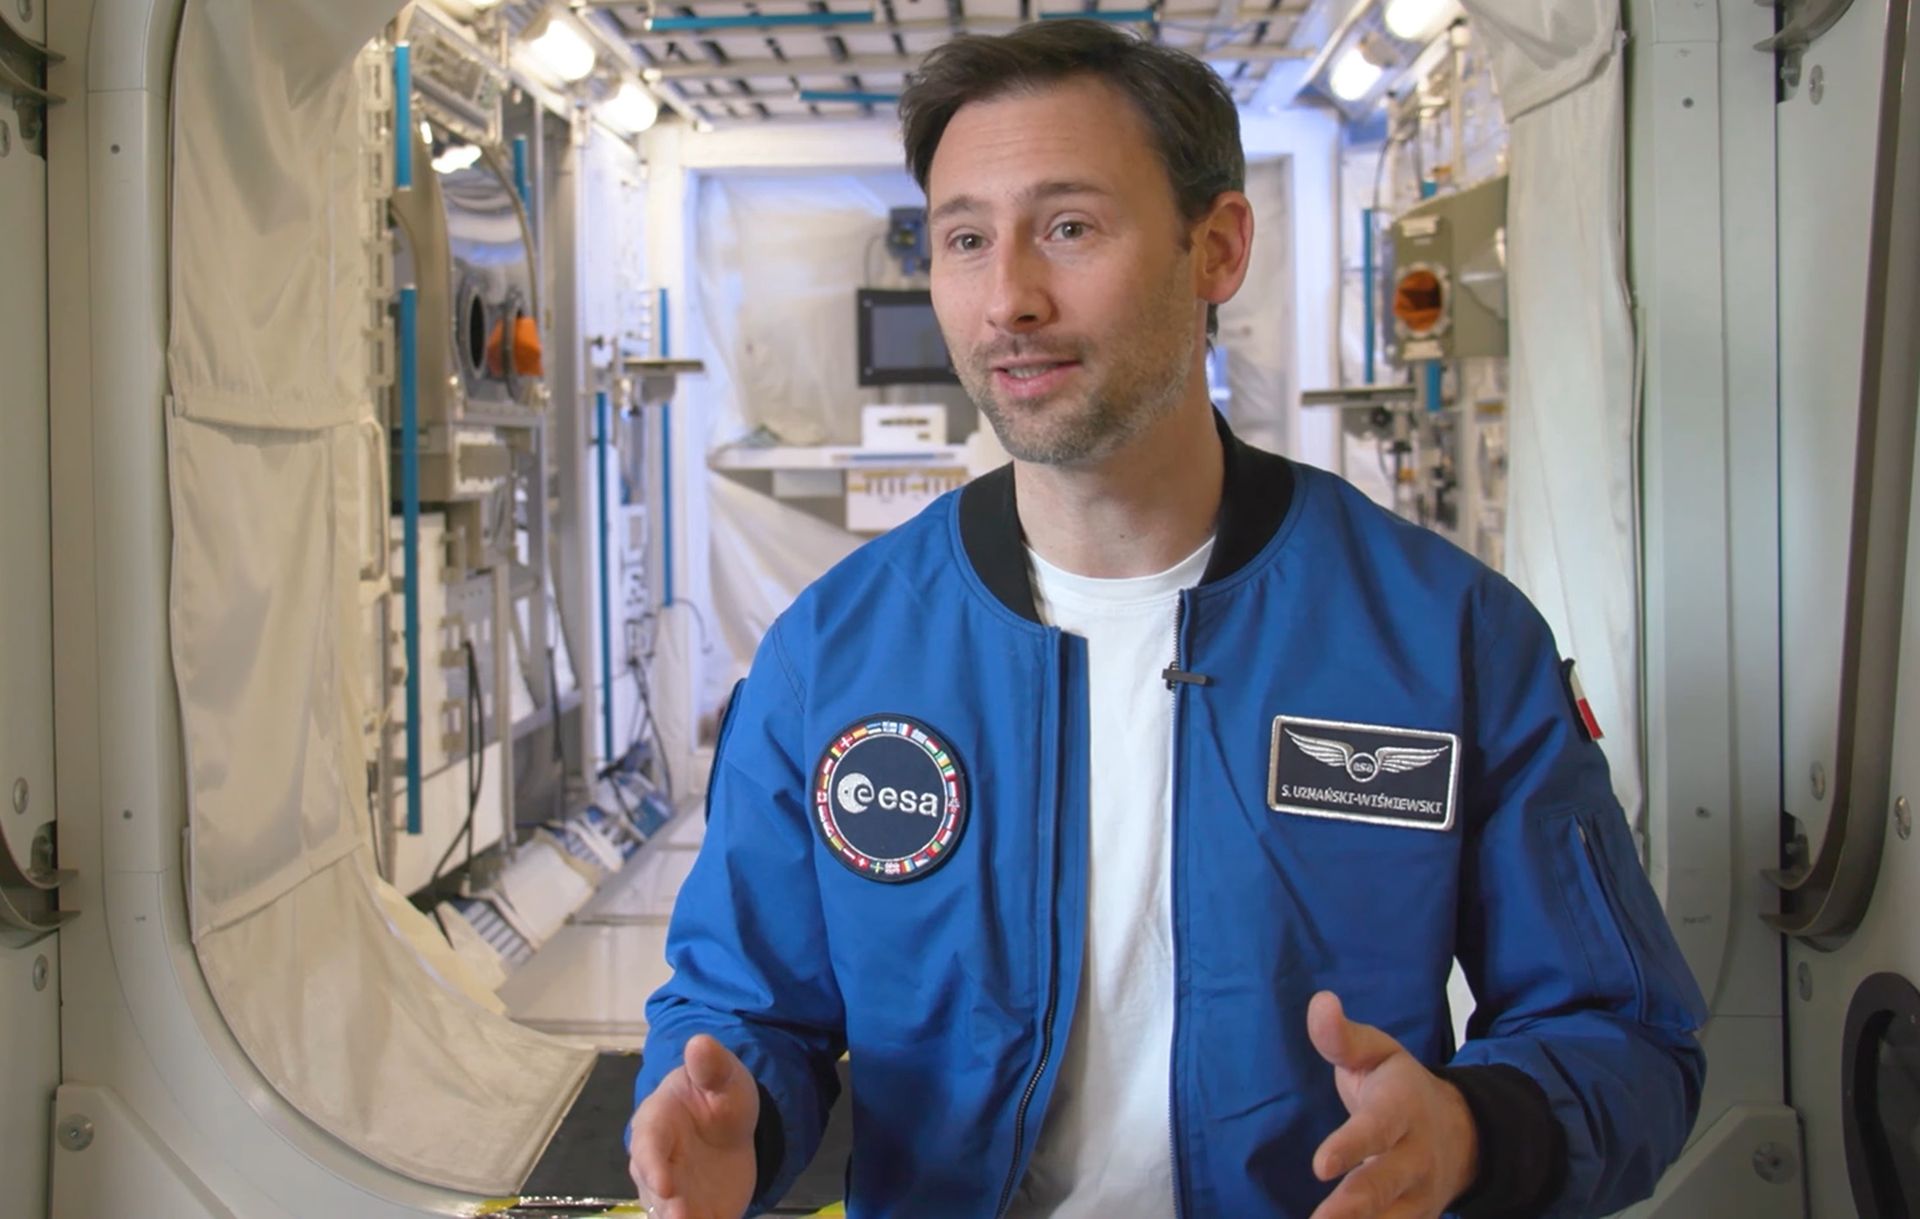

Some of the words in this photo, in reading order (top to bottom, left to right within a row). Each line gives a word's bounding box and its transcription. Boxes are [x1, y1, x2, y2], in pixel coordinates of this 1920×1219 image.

[1353, 762, 1374, 773] esa
[1281, 784, 1292, 798] S.
[878, 787, 938, 817] esa
